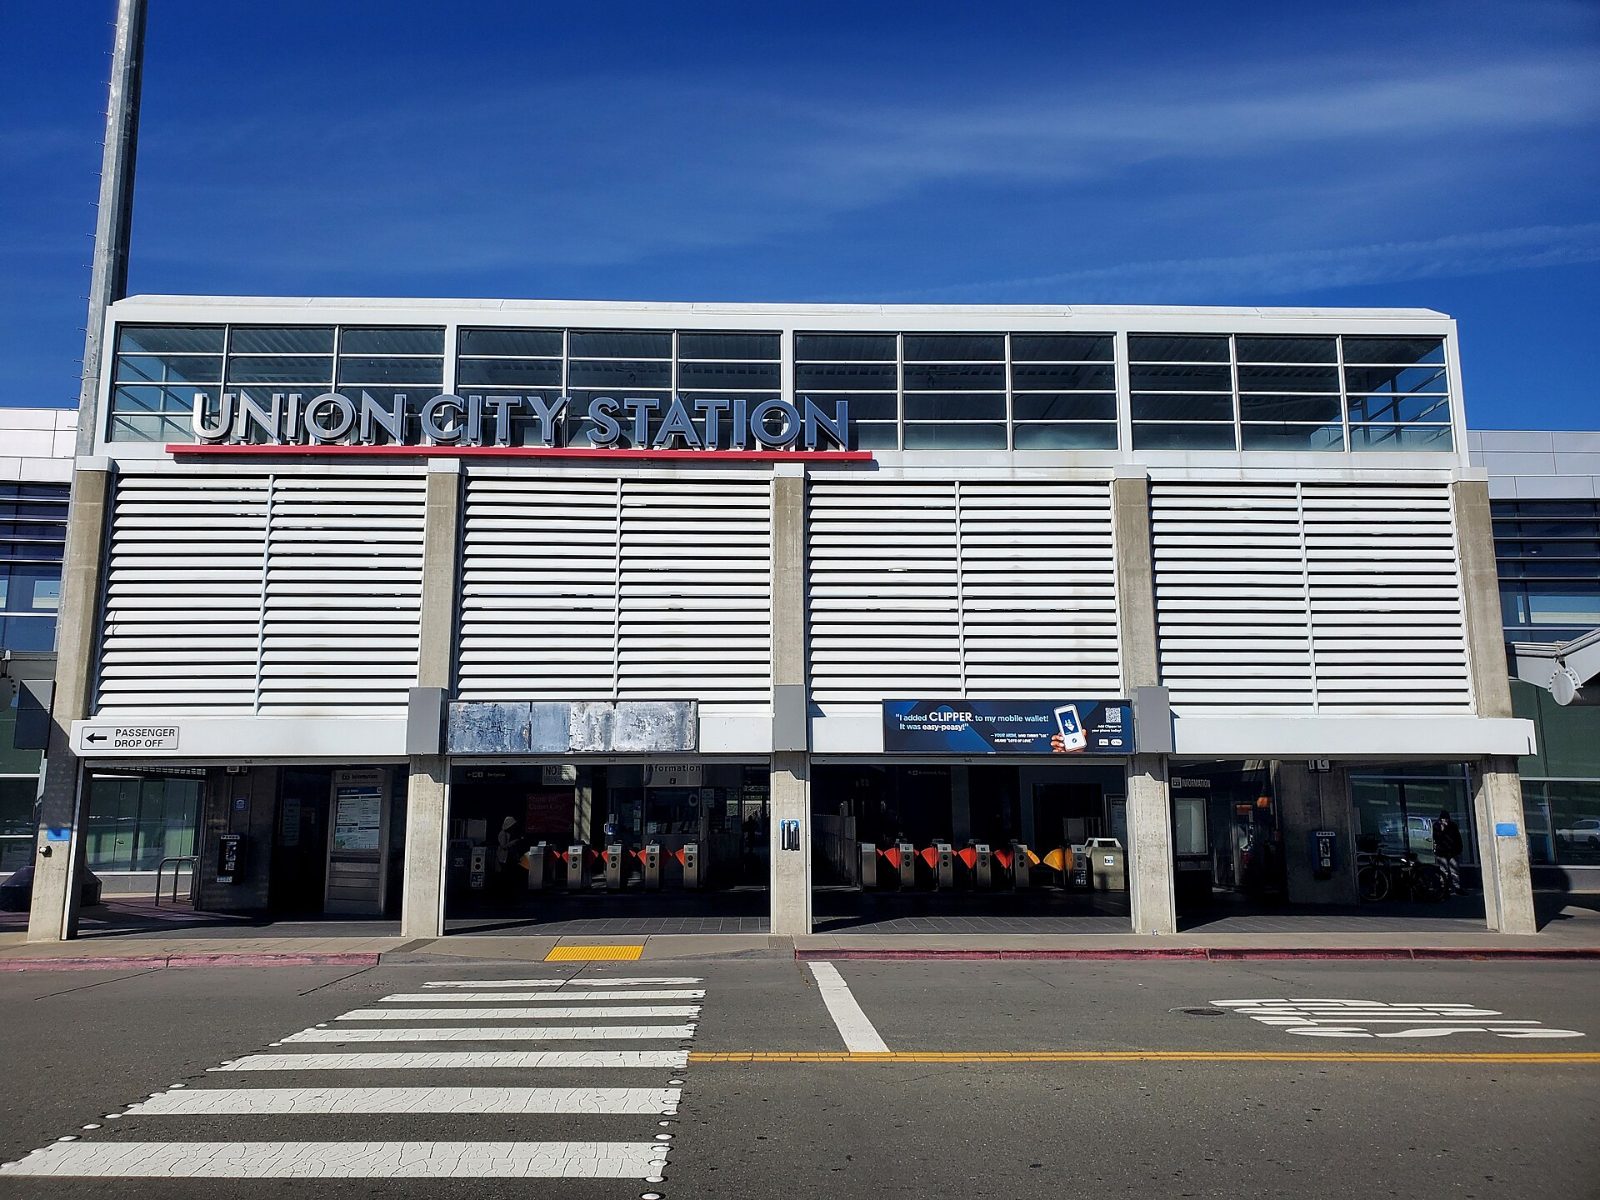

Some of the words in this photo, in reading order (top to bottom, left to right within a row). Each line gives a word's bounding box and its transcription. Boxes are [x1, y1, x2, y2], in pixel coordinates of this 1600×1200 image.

[192, 388, 407, 445] UNION
[421, 394, 573, 449] CITY
[586, 394, 849, 452] STATION
[903, 713, 928, 722] added
[975, 714, 984, 722] to
[984, 715, 996, 724] my
[997, 714, 1024, 722] mobile
[1024, 715, 1050, 723] wallet!
[922, 723, 969, 732] easy-peasy!"
[115, 728, 175, 737] PASSENGER
[114, 739, 142, 748] DROP
[144, 739, 164, 748] OFF
